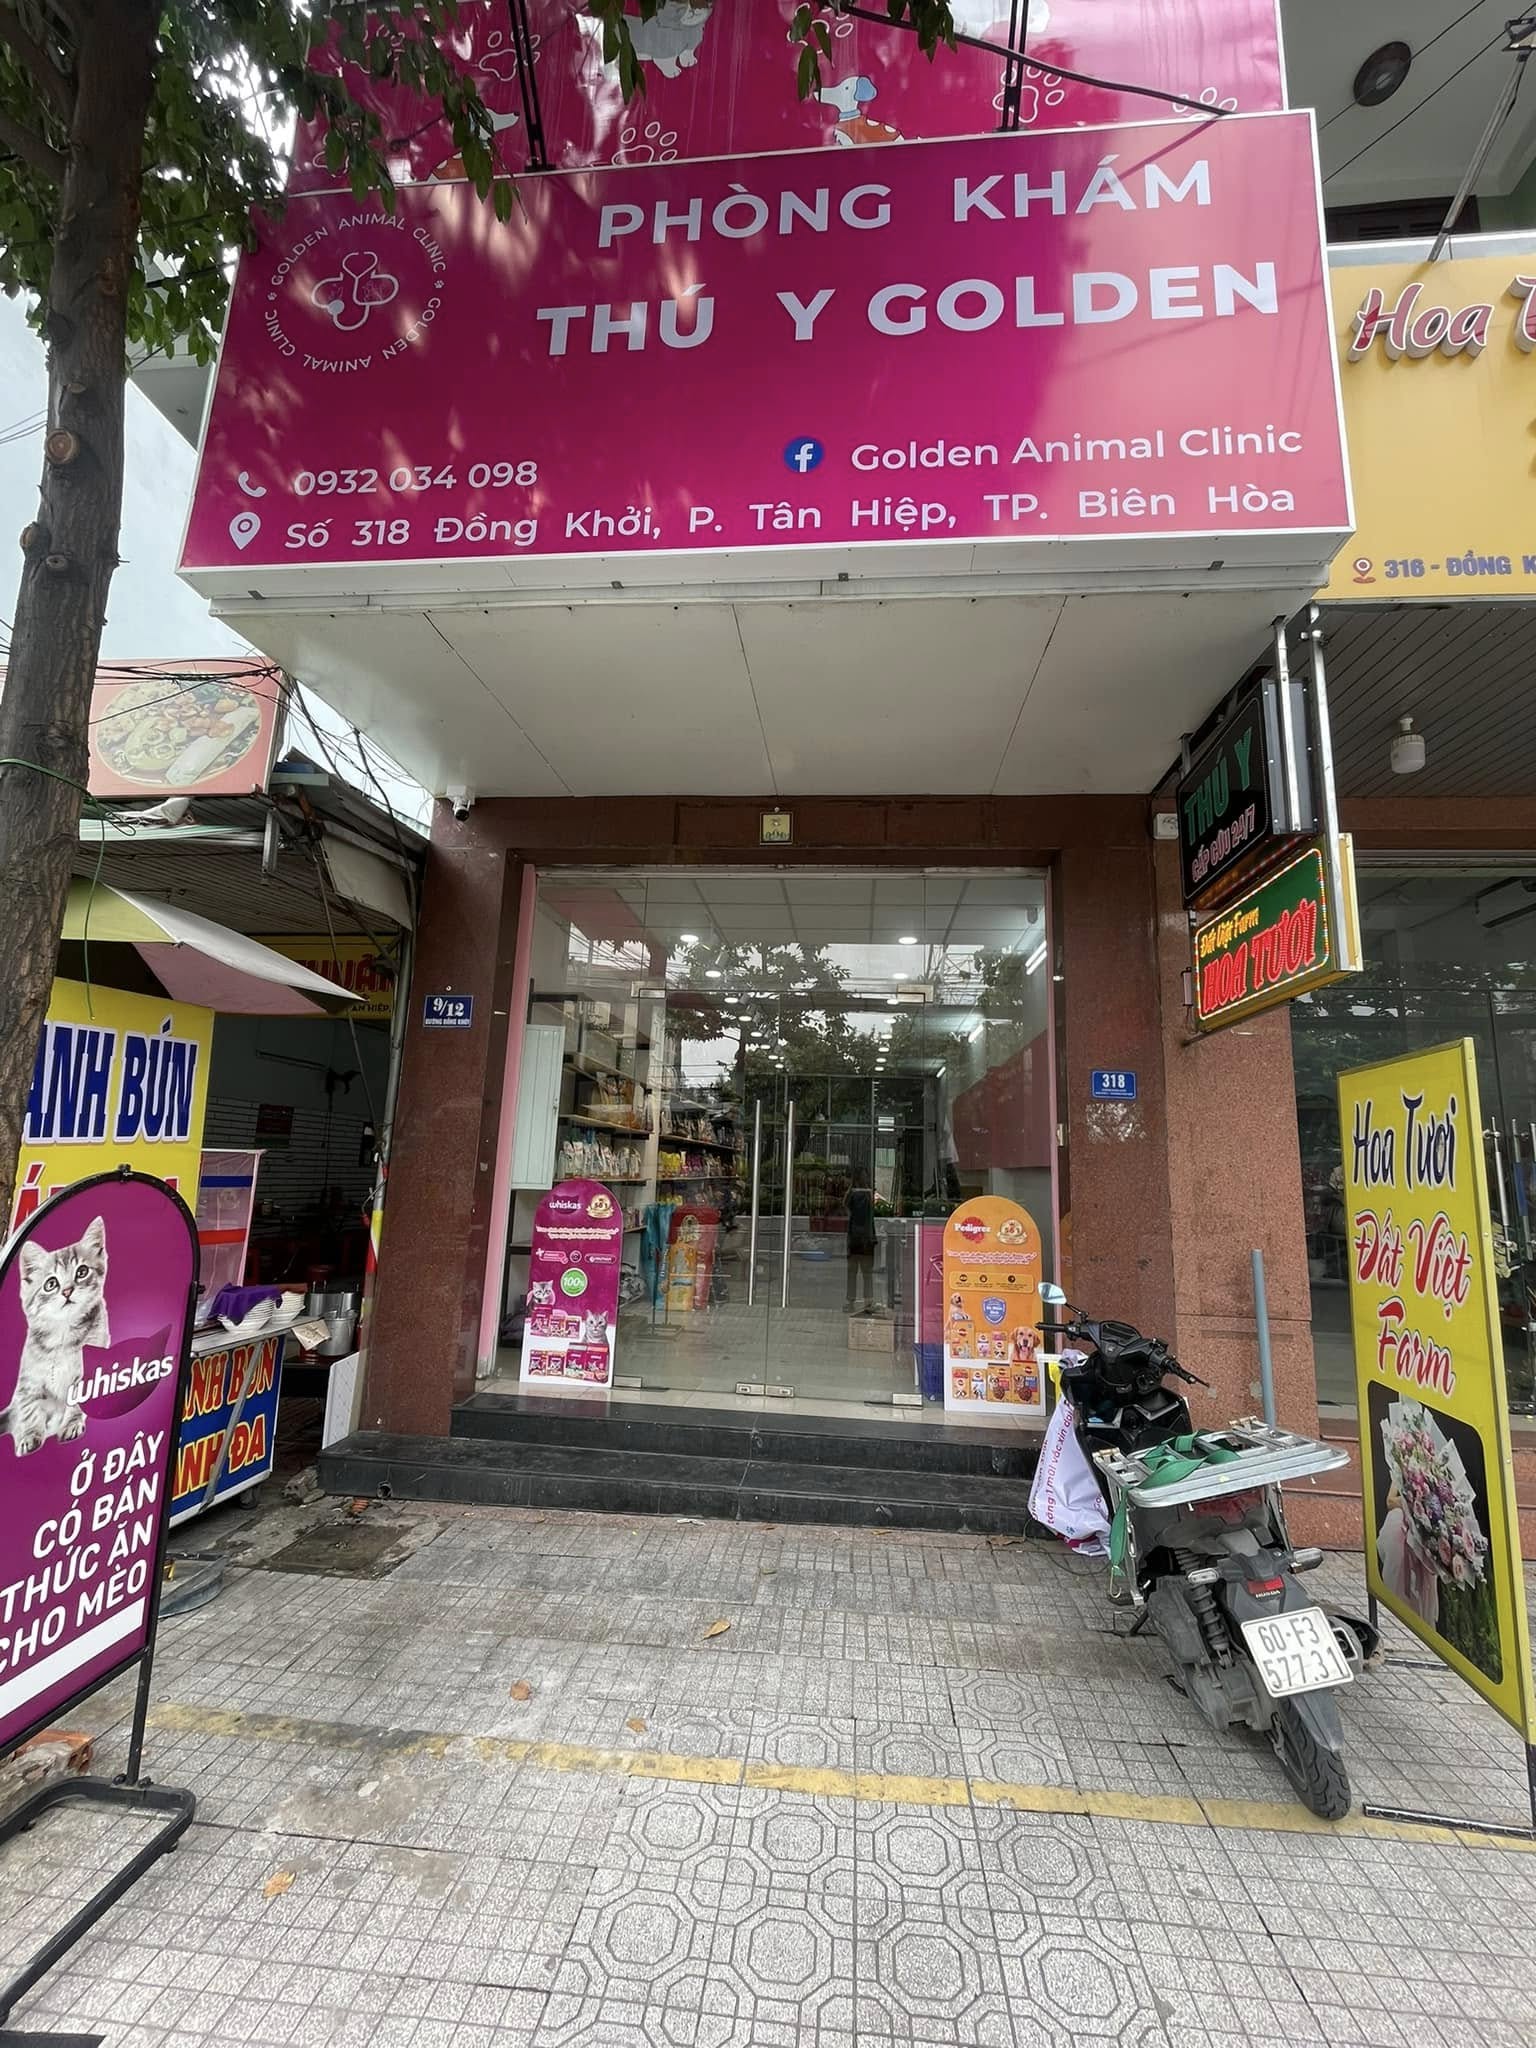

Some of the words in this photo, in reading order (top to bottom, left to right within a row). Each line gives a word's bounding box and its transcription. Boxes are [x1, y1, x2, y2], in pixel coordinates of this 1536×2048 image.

[599, 184, 892, 248] PHÒNG
[953, 155, 1212, 222] KHÁM
[272, 227, 328, 286] GOLDEN
[338, 213, 405, 231] ANIMAL
[413, 227, 446, 273] CLINIC
[265, 310, 296, 356] CLINIC
[382, 297, 441, 360] GOLDEN
[536, 283, 714, 356] THÚ
[776, 288, 835, 341] Y
[867, 261, 1279, 336] GOLDEN
[1351, 282, 1495, 354] Hoa
[303, 354, 372, 373] ANIMAL
[294, 468, 378, 498] 0932
[388, 465, 457, 492] 034
[467, 461, 539, 488] 098
[851, 437, 999, 472] Golden
[1011, 429, 1165, 465] Animal
[1179, 423, 1303, 456] Clinic
[285, 515, 330, 549] Số
[352, 517, 410, 546] 318
[434, 512, 539, 547] Đồng
[564, 504, 662, 541] Khởi,
[688, 505, 722, 533] P.
[749, 502, 822, 530] Tân
[851, 495, 957, 532] Hiệp,
[984, 492, 1048, 521] TP.
[1078, 487, 1176, 518] Biên
[1208, 483, 1296, 513] Hòa
[1384, 558, 1425, 579] 316
[1184, 747, 1230, 846] THÚ
[1234, 726, 1252, 791] Y
[1231, 803, 1256, 848] 24/7
[433, 997, 464, 1017] 9/12
[1203, 942, 1248, 1014] HOA
[26, 1022, 117, 1141] ANH
[116, 1014, 199, 1141] BÚN
[1102, 1073, 1125, 1089] 318
[1352, 1099, 1395, 1188] Hoa
[549, 1200, 581, 1209] whiskas
[954, 1223, 991, 1234] Pedigree
[1354, 1208, 1404, 1289] Đất
[1408, 1210, 1473, 1321] Việt
[1377, 1295, 1456, 1397] Farm
[66, 1355, 174, 1406] whiskas
[181, 1350, 230, 1422] NH
[70, 1448, 97, 1497] Ở
[102, 1430, 164, 1484] ĐÂY
[228, 1414, 266, 1474] ĐA
[33, 1499, 82, 1559] CÓ
[92, 1471, 159, 1532] BÁN
[0, 1541, 101, 1624] THỨC
[107, 1514, 154, 1567] ĂN
[76, 1558, 147, 1628] MÈO
[1262, 1646, 1345, 1689] 577.31
